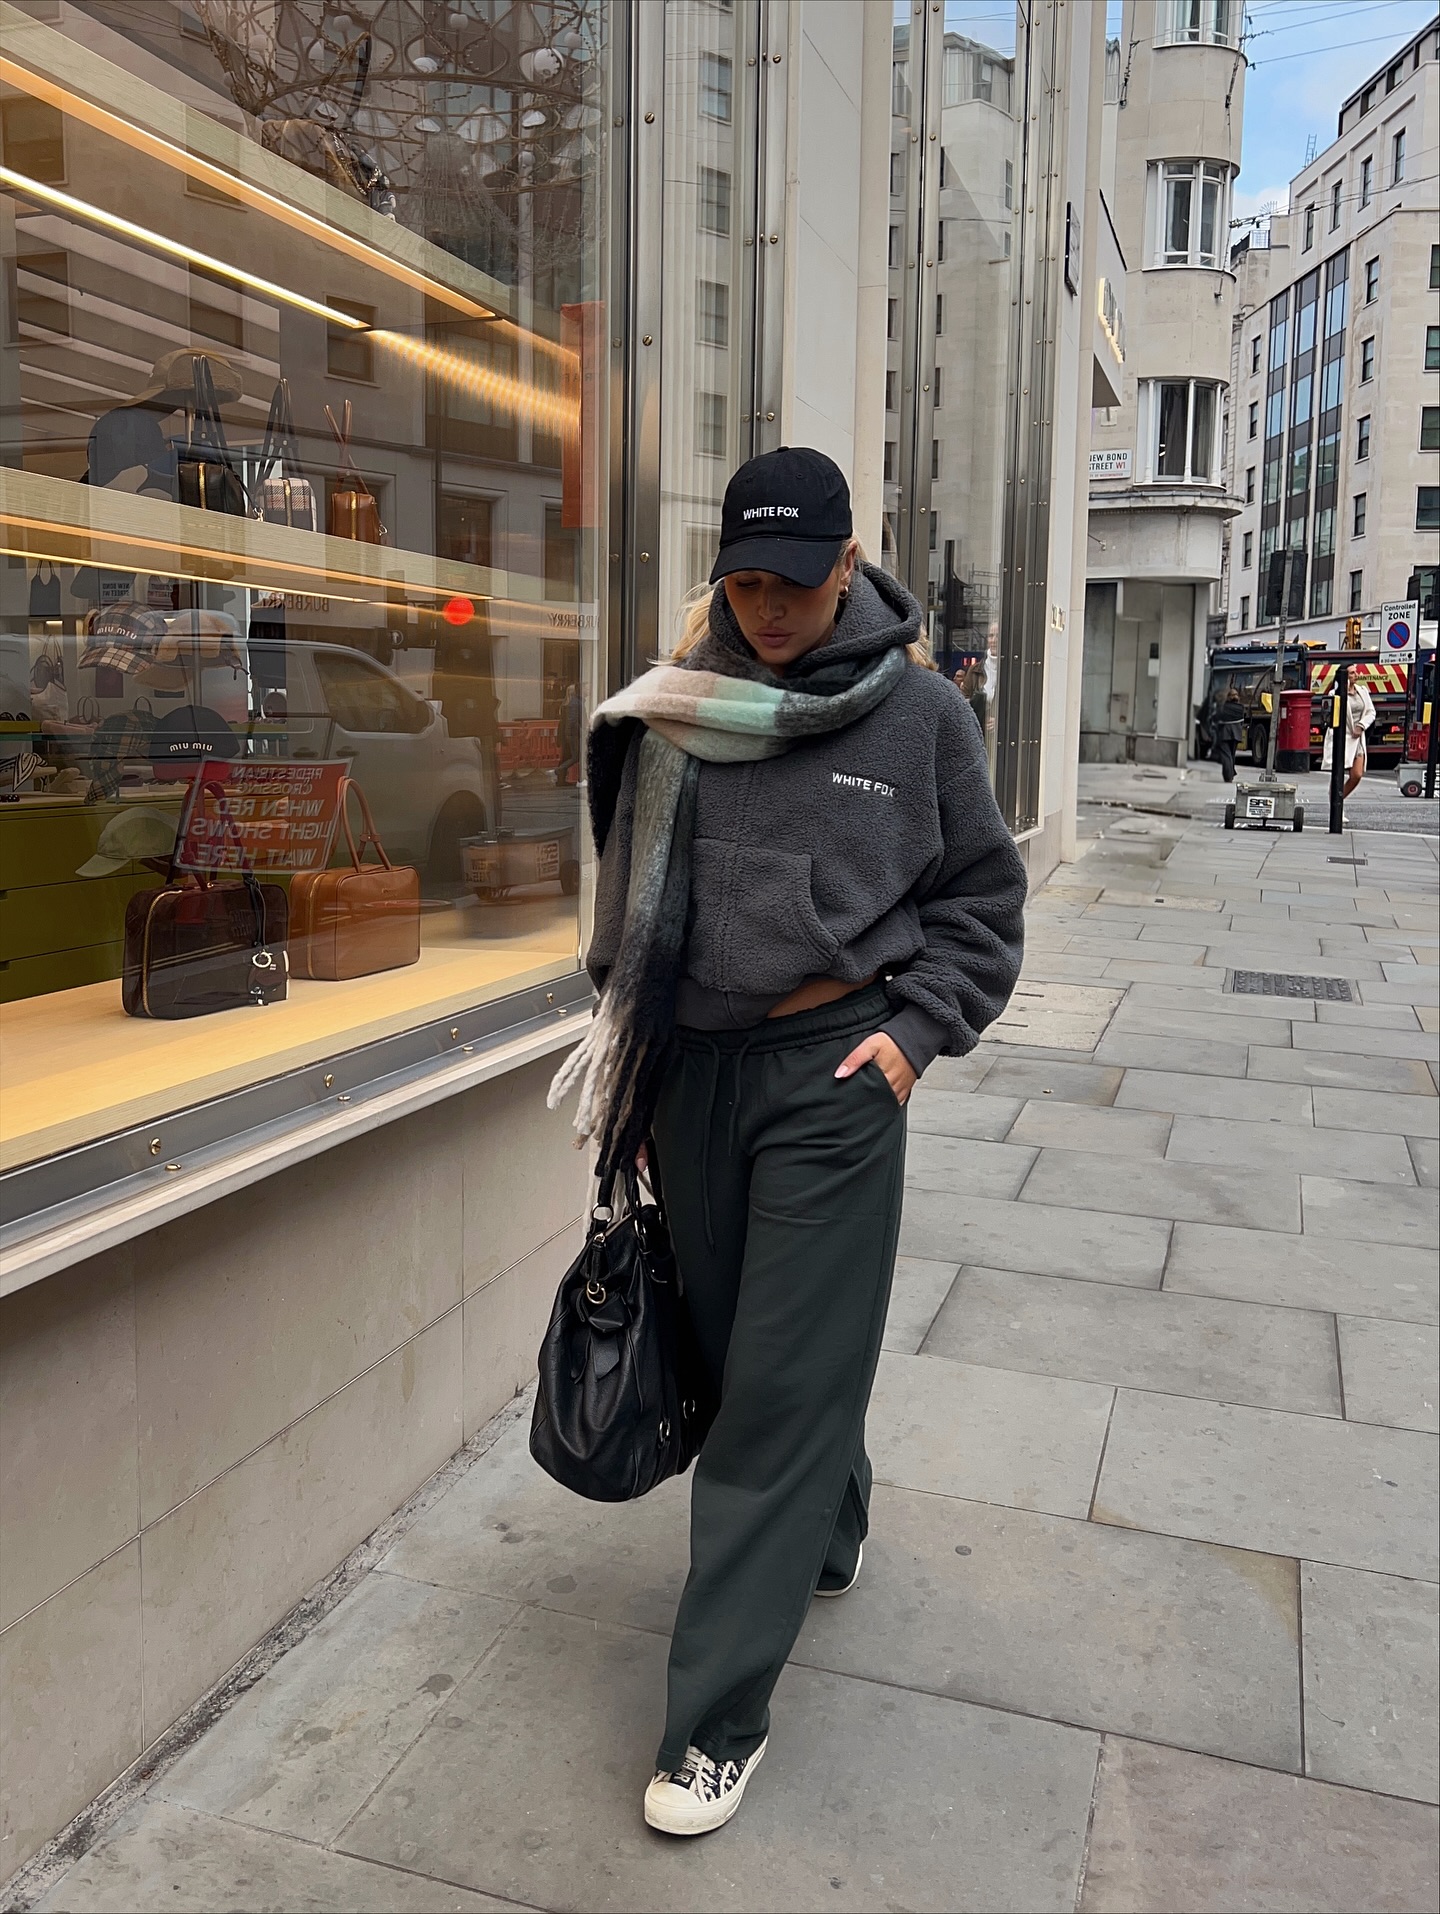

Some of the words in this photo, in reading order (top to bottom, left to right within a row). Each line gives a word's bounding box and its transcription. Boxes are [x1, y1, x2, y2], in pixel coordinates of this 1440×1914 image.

[1106, 453, 1128, 461] BOND
[1115, 461, 1126, 469] W1
[743, 506, 776, 520] WHITE
[777, 506, 799, 518] FOX
[1384, 603, 1416, 611] Controlled
[1388, 611, 1411, 620] ZONE
[832, 772, 873, 791] WHITE
[873, 781, 896, 798] FOX
